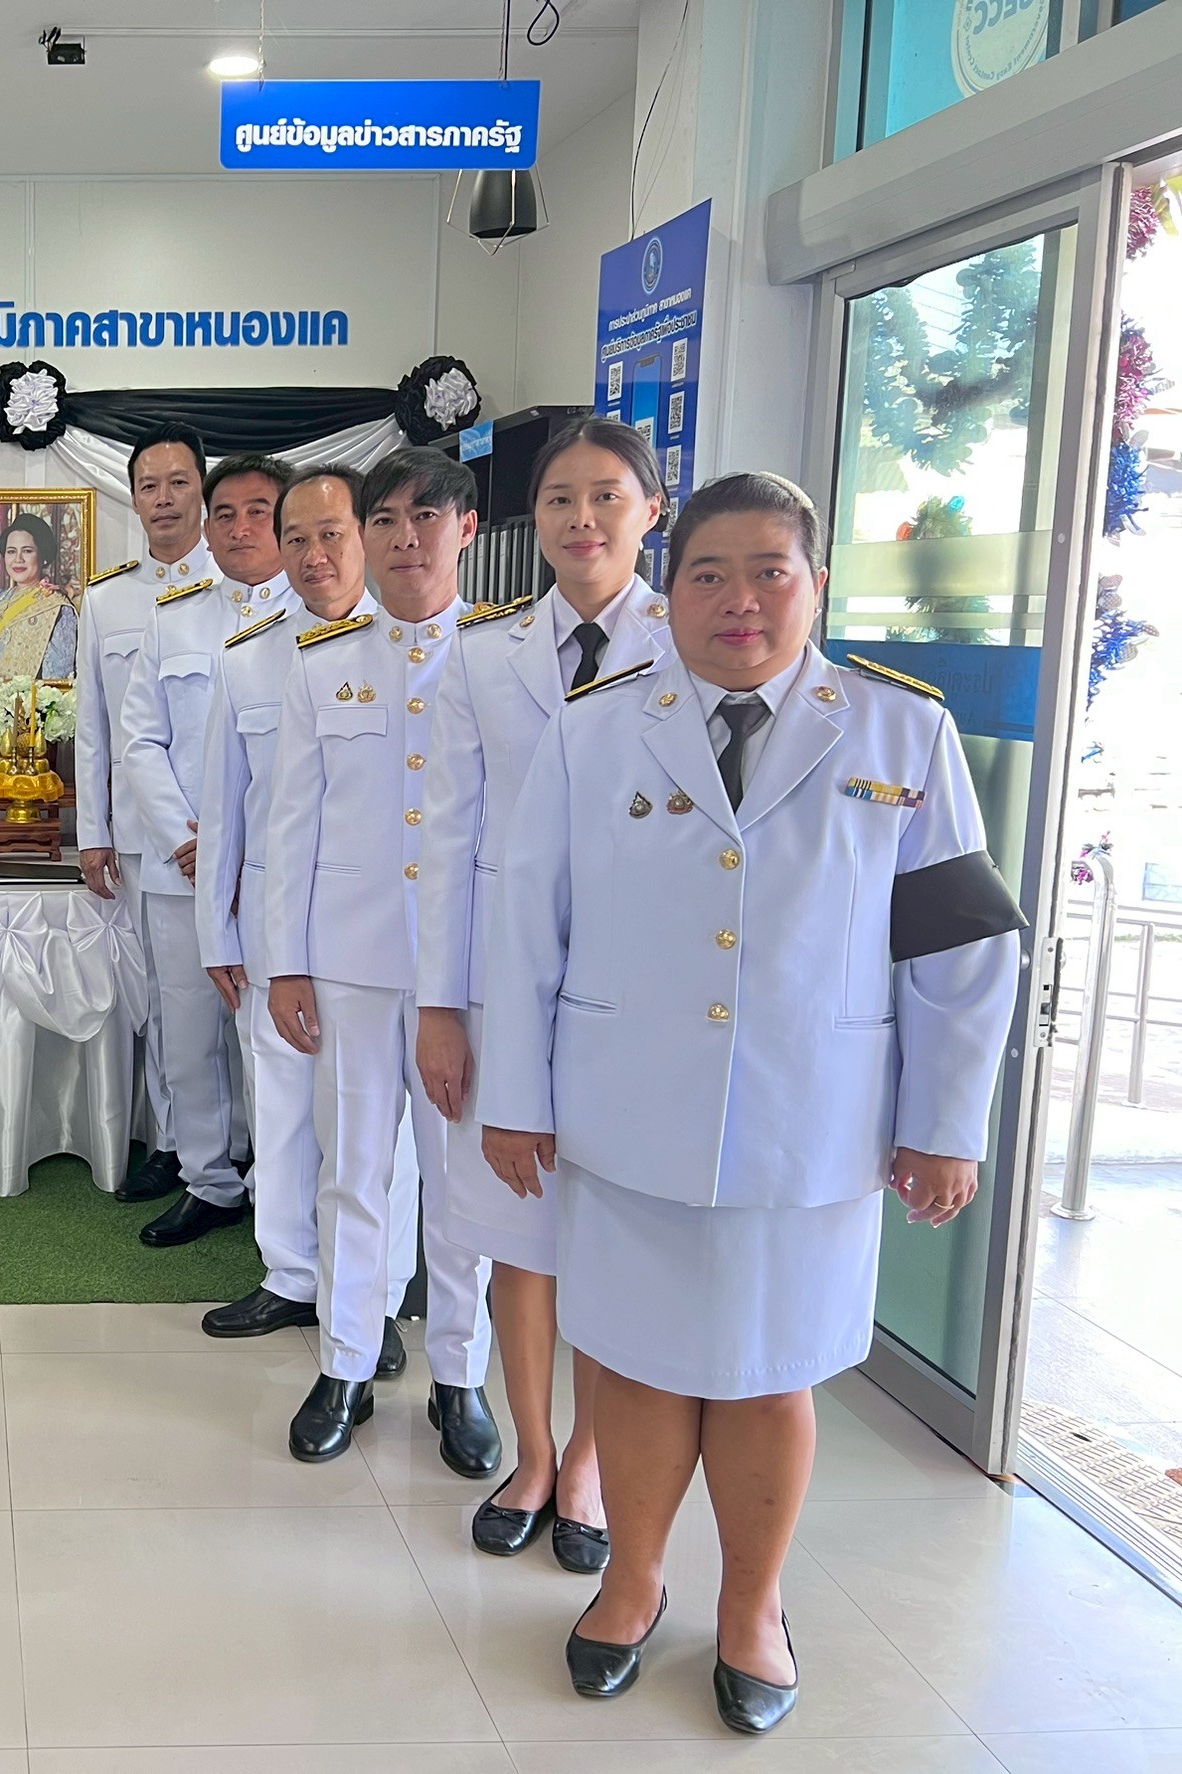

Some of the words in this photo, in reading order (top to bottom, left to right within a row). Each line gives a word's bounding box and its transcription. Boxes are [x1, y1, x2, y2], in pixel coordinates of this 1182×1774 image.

[235, 117, 523, 153] ศูนย์ข้อมูลข่าวสารภาครัฐ
